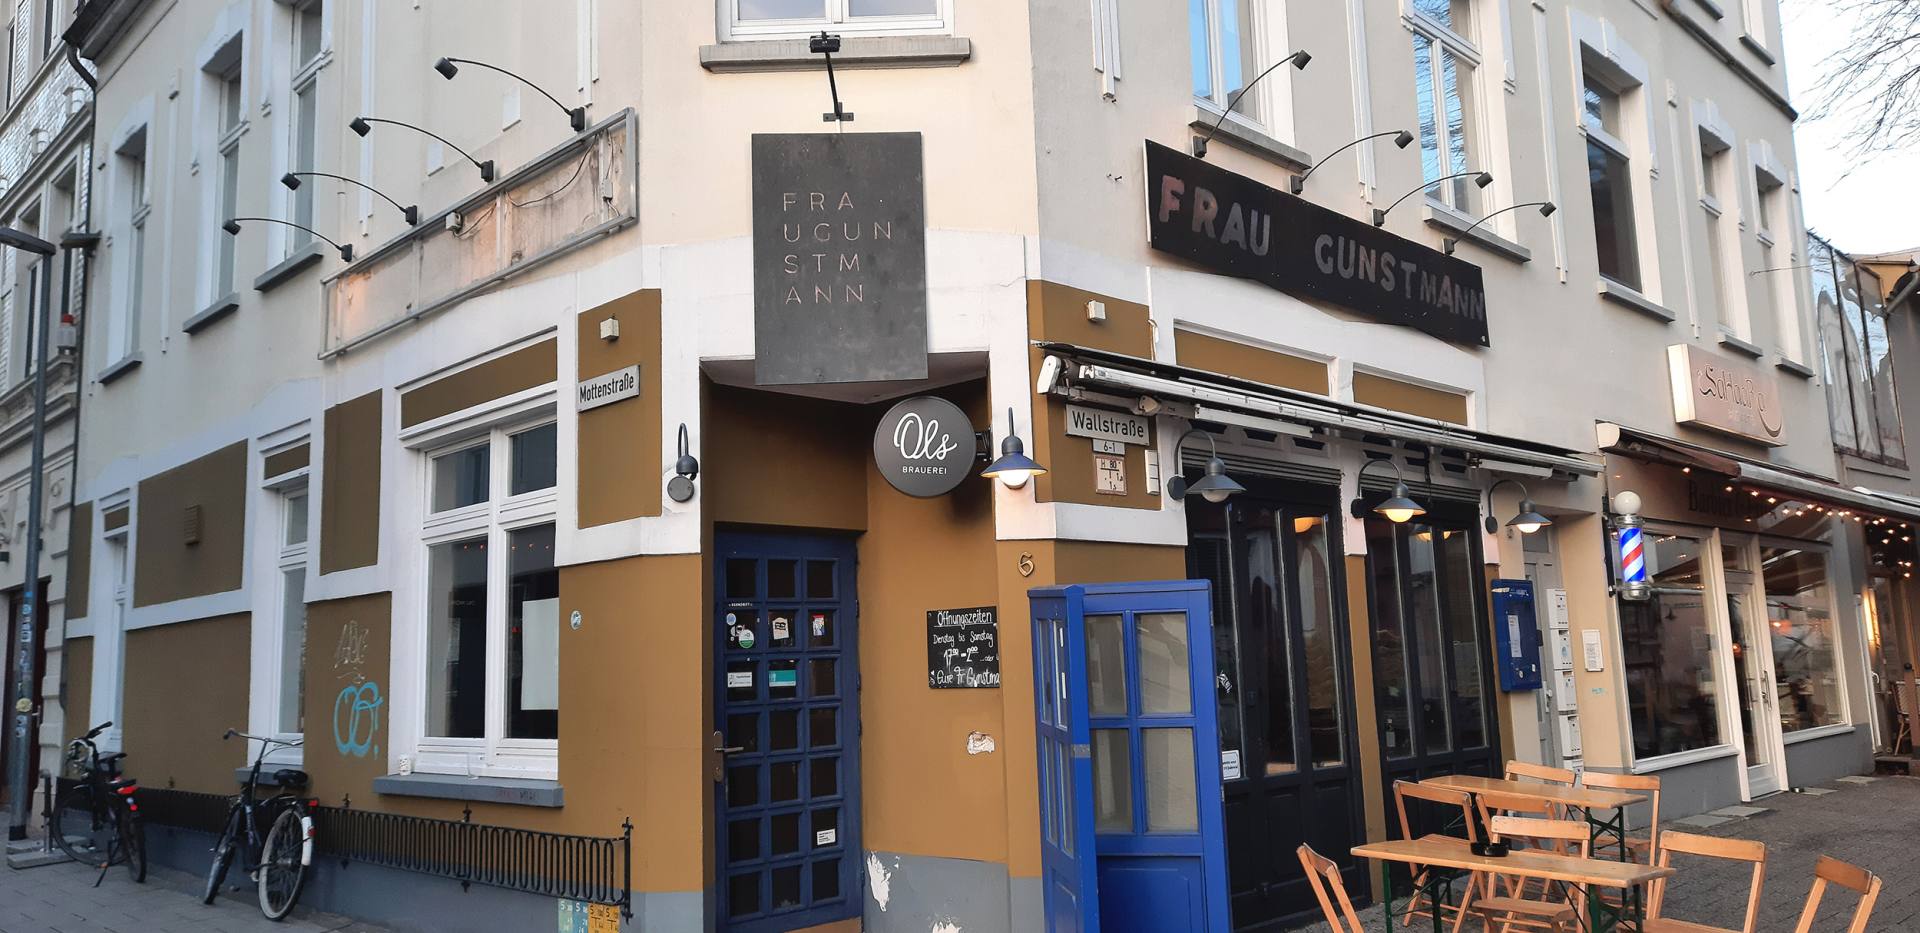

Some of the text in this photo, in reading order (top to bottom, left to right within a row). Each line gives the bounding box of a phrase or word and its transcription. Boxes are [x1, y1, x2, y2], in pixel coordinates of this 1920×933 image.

[783, 191, 854, 212] FRA
[784, 221, 892, 243] UGUN
[1159, 175, 1484, 321] FRAU GUNSTMANN
[784, 253, 860, 274] STM
[785, 284, 864, 305] ANN
[579, 372, 634, 403] Mottenstraße
[1072, 410, 1144, 438] Wallstraße
[893, 412, 957, 460] Ols
[1103, 441, 1116, 453] 6-1
[902, 465, 947, 475] BRAUEREI
[1018, 551, 1035, 578] 6
[937, 609, 992, 630] Öffnungszeiten
[933, 629, 994, 648] Dienstag bis Samstag
[937, 669, 954, 685] Eure
